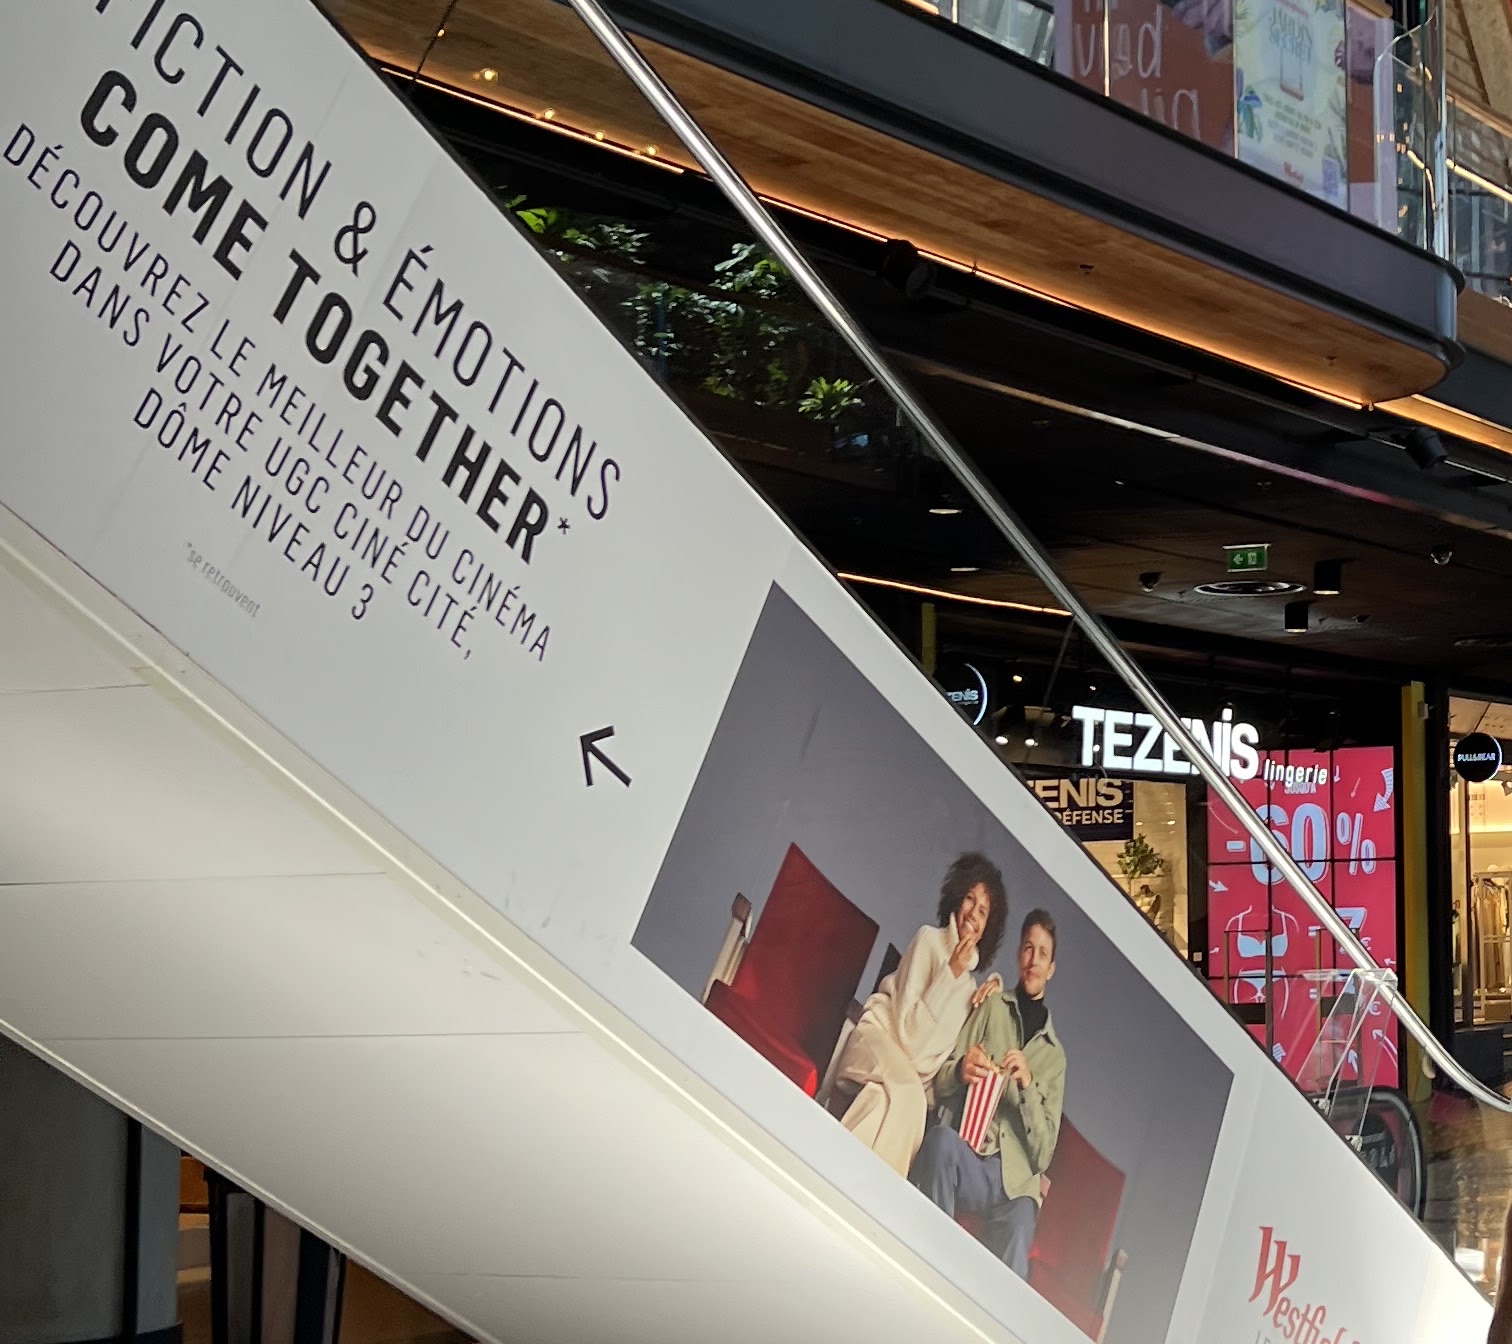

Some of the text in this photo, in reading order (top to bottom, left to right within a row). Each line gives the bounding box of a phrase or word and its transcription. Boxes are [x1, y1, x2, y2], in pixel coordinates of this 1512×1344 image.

[81, 70, 269, 280] COME
[3, 123, 551, 661] DÉCOUVREZ LE MEILLEUR DU CINÉMA
[50, 240, 477, 659] DANS VOTRE UGC CINÉ CITÉ,
[334, 201, 377, 276] &
[383, 245, 621, 521] ÉMOTIONS
[134, 388, 375, 620] DÔME NIVEAU 3
[1264, 759, 1328, 787] lingerie
